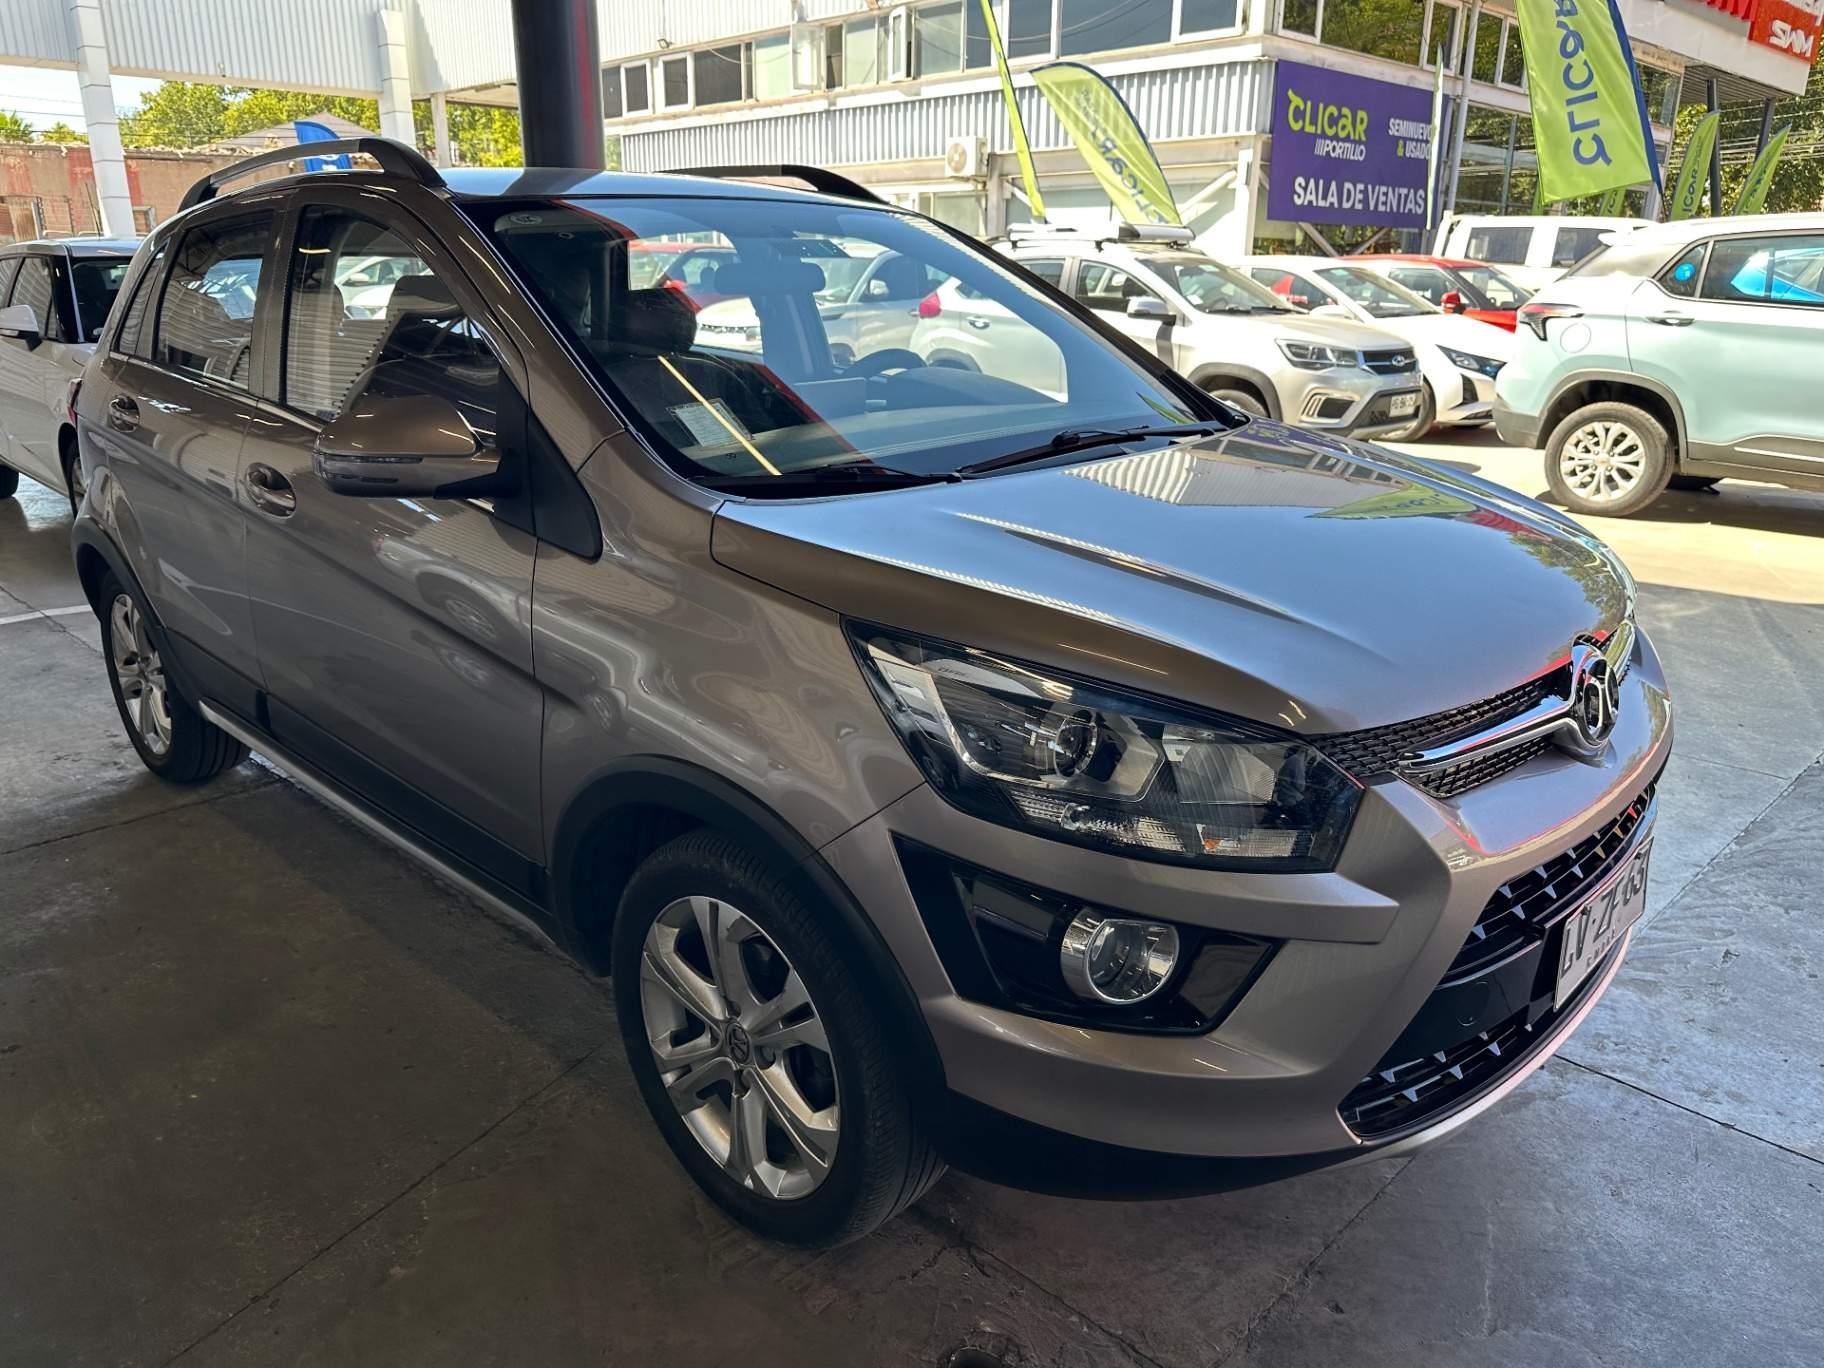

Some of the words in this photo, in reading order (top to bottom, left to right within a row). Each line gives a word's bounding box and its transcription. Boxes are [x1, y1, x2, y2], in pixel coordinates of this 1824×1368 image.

[1769, 19, 1815, 57] SWM
[1388, 118, 1432, 141] SEMINUEVO
[1396, 139, 1404, 157] &
[1405, 140, 1432, 160] USADO
[1293, 176, 1338, 208] SALA
[1342, 181, 1364, 210] DE
[1368, 184, 1425, 214] VENTAS
